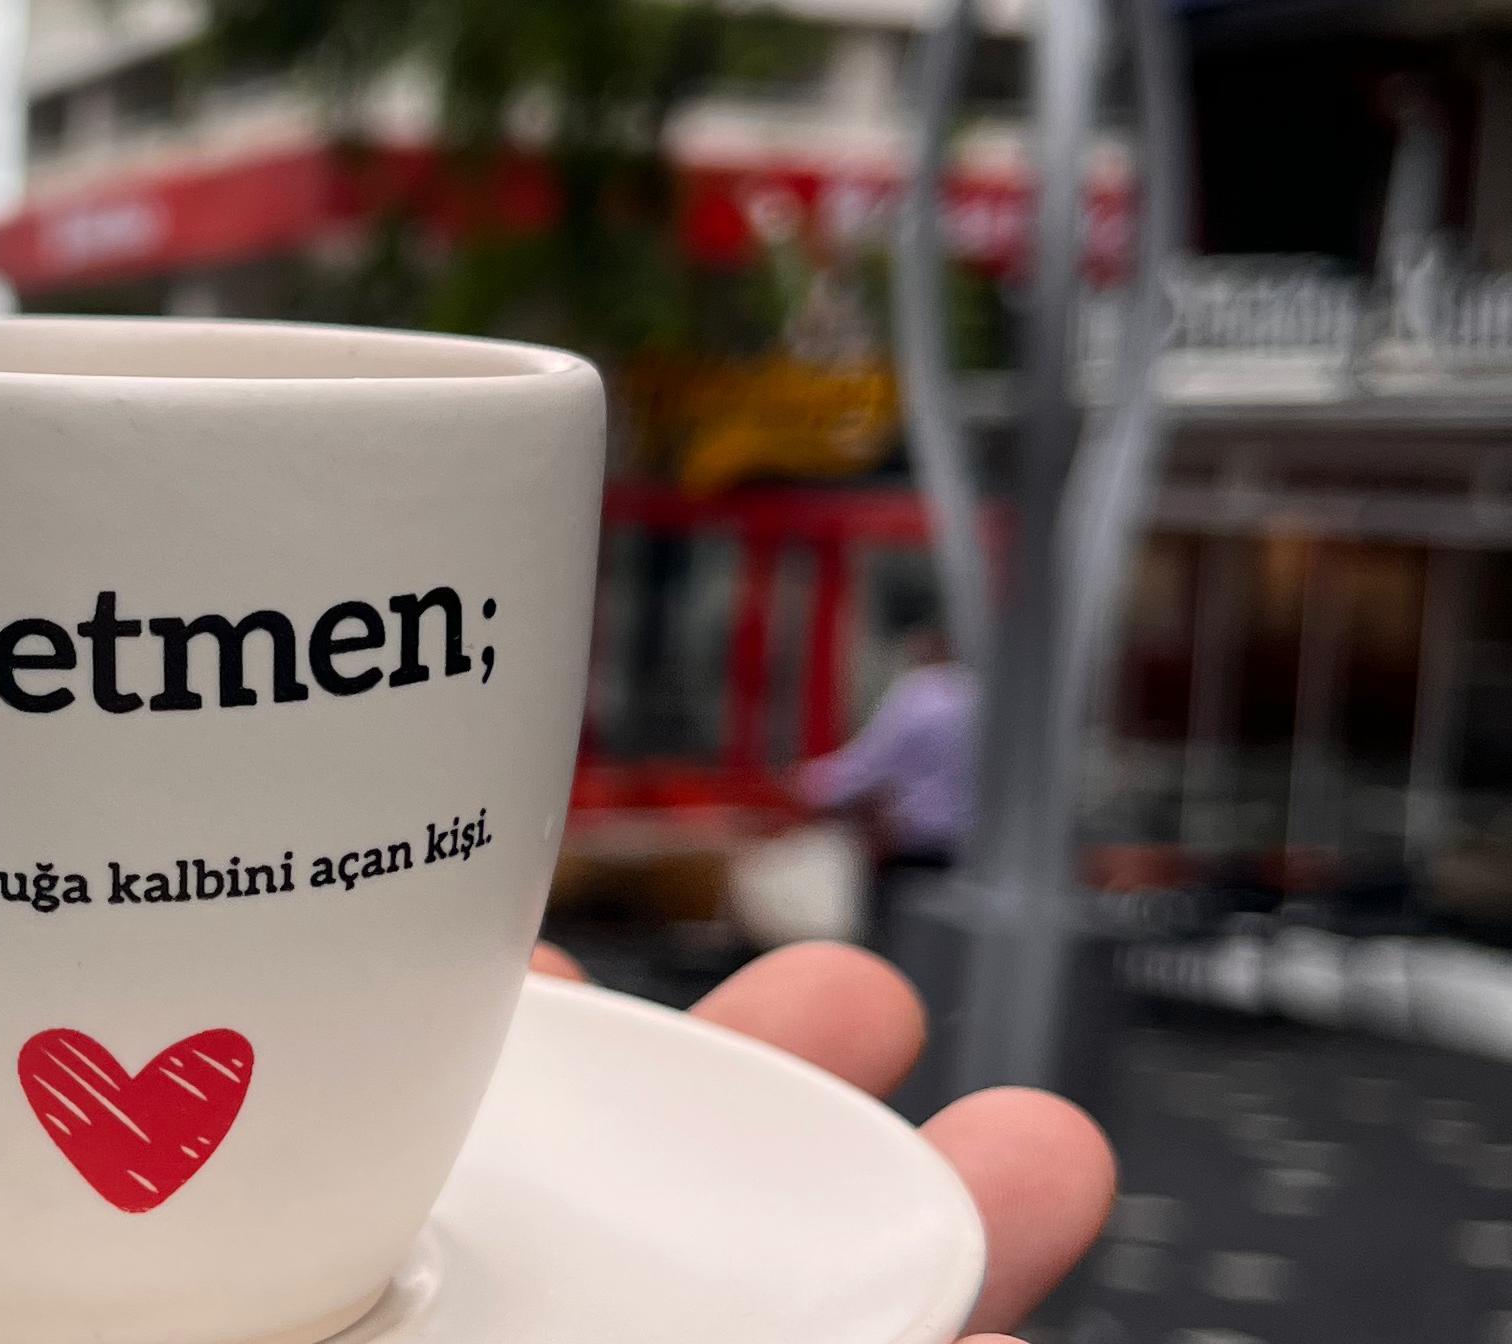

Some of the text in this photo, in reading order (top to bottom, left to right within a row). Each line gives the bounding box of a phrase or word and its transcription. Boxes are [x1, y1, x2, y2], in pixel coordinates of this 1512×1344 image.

[107, 850, 296, 906] kalbini
[309, 841, 414, 892] açan
[423, 807, 493, 866] kişi.
